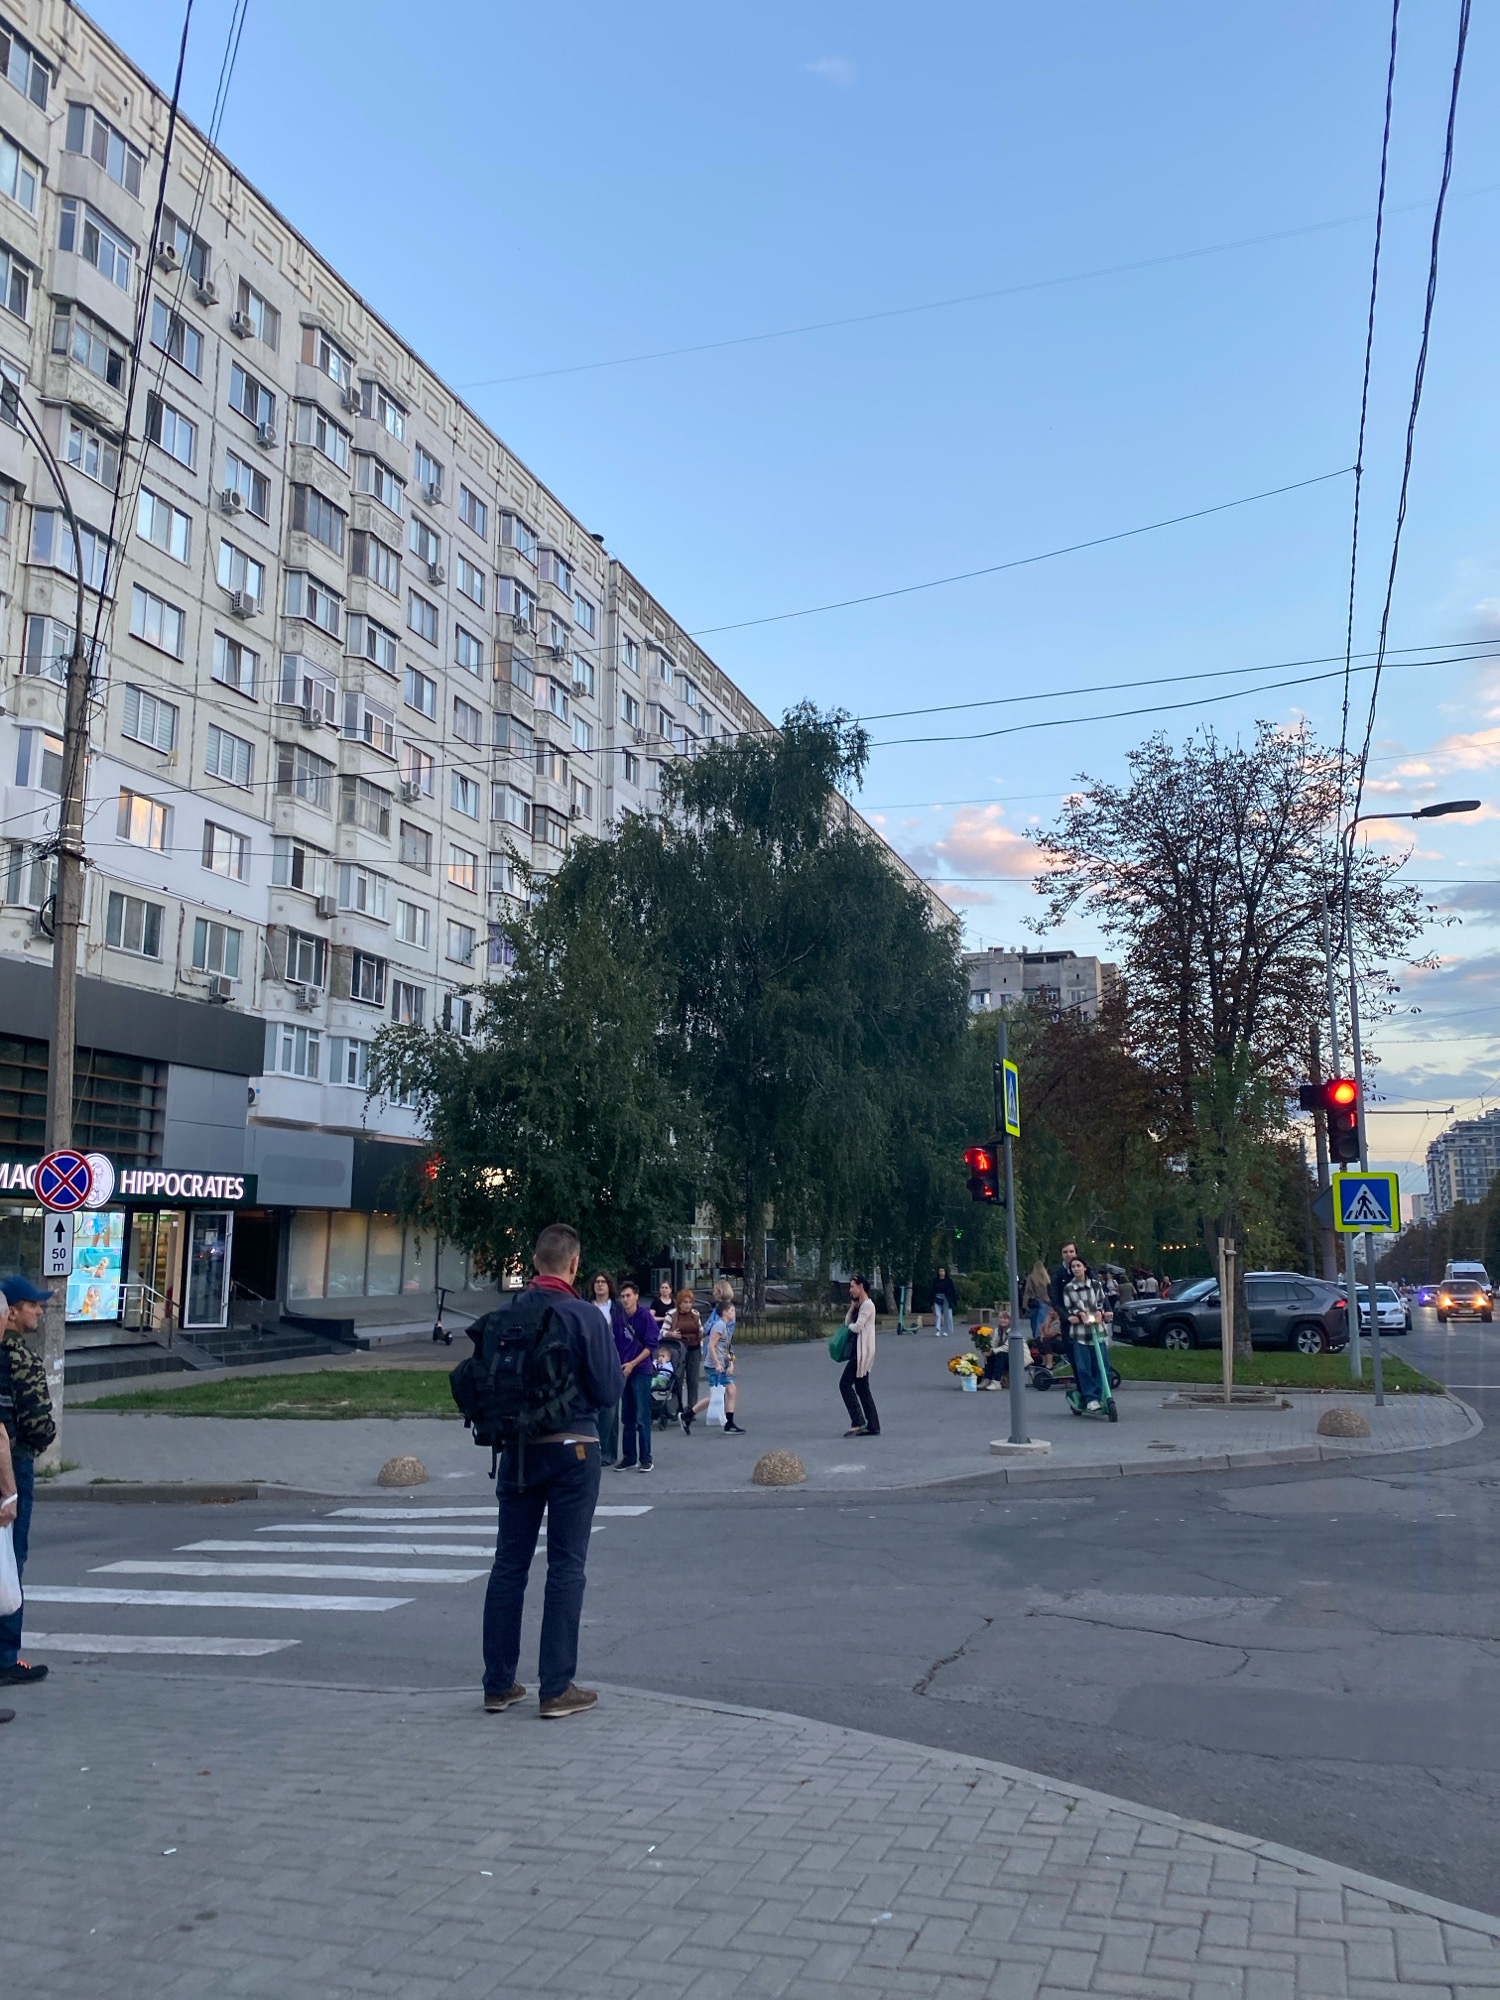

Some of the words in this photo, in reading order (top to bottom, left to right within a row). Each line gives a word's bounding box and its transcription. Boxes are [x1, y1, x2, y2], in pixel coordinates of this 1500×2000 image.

[119, 1170, 245, 1200] HIPPOCRATES
[52, 1248, 66, 1259] 50
[53, 1263, 64, 1271] m
